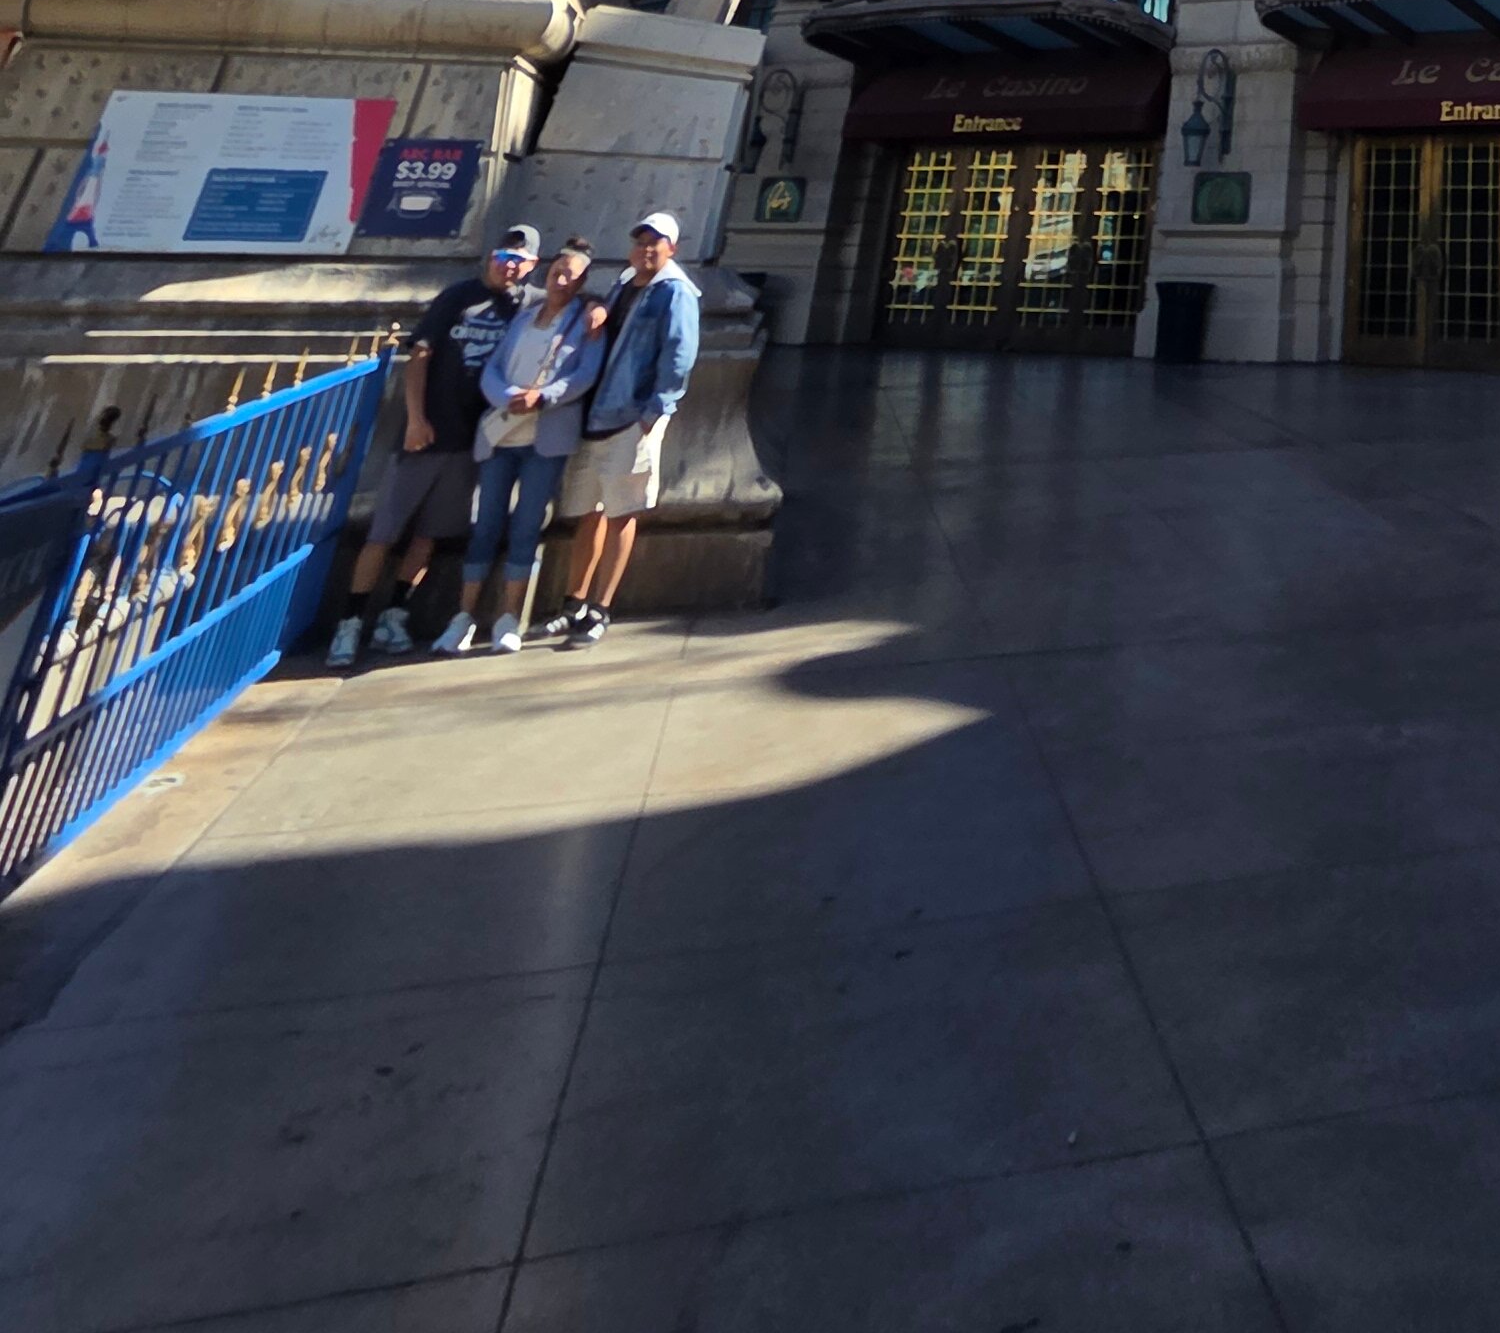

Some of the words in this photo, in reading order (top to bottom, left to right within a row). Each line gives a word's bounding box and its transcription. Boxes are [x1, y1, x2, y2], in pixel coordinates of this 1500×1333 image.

[1391, 59, 1441, 86] Le
[952, 113, 1023, 133] Entrance
[395, 160, 457, 181] $3.99
